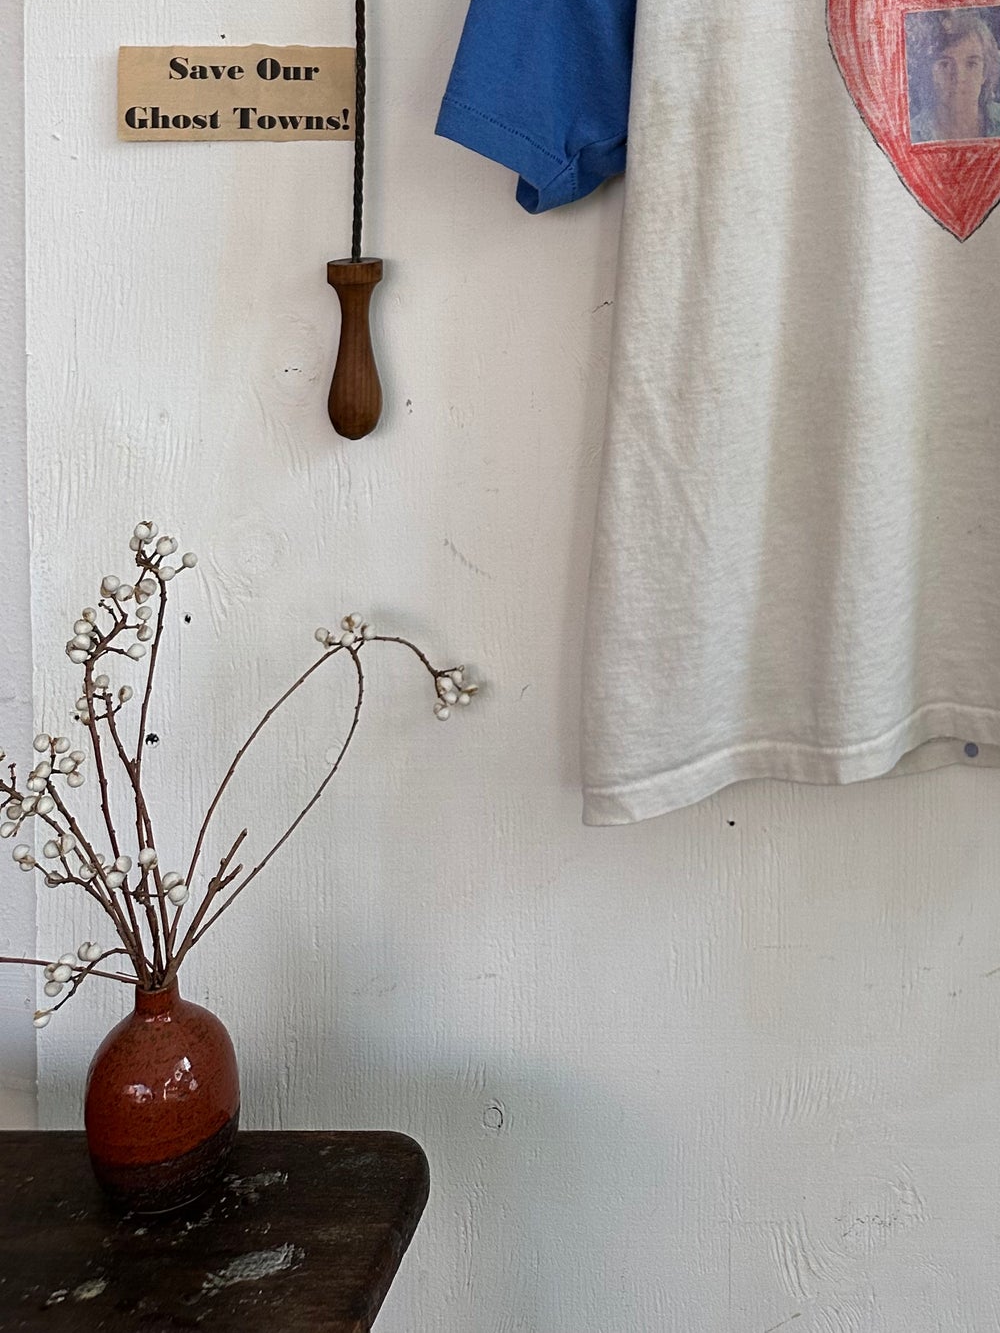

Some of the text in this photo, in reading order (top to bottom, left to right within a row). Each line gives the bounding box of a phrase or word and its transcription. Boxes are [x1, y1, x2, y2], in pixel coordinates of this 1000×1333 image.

[169, 57, 320, 81] Save Our
[124, 106, 350, 131] Ghost Towns!
